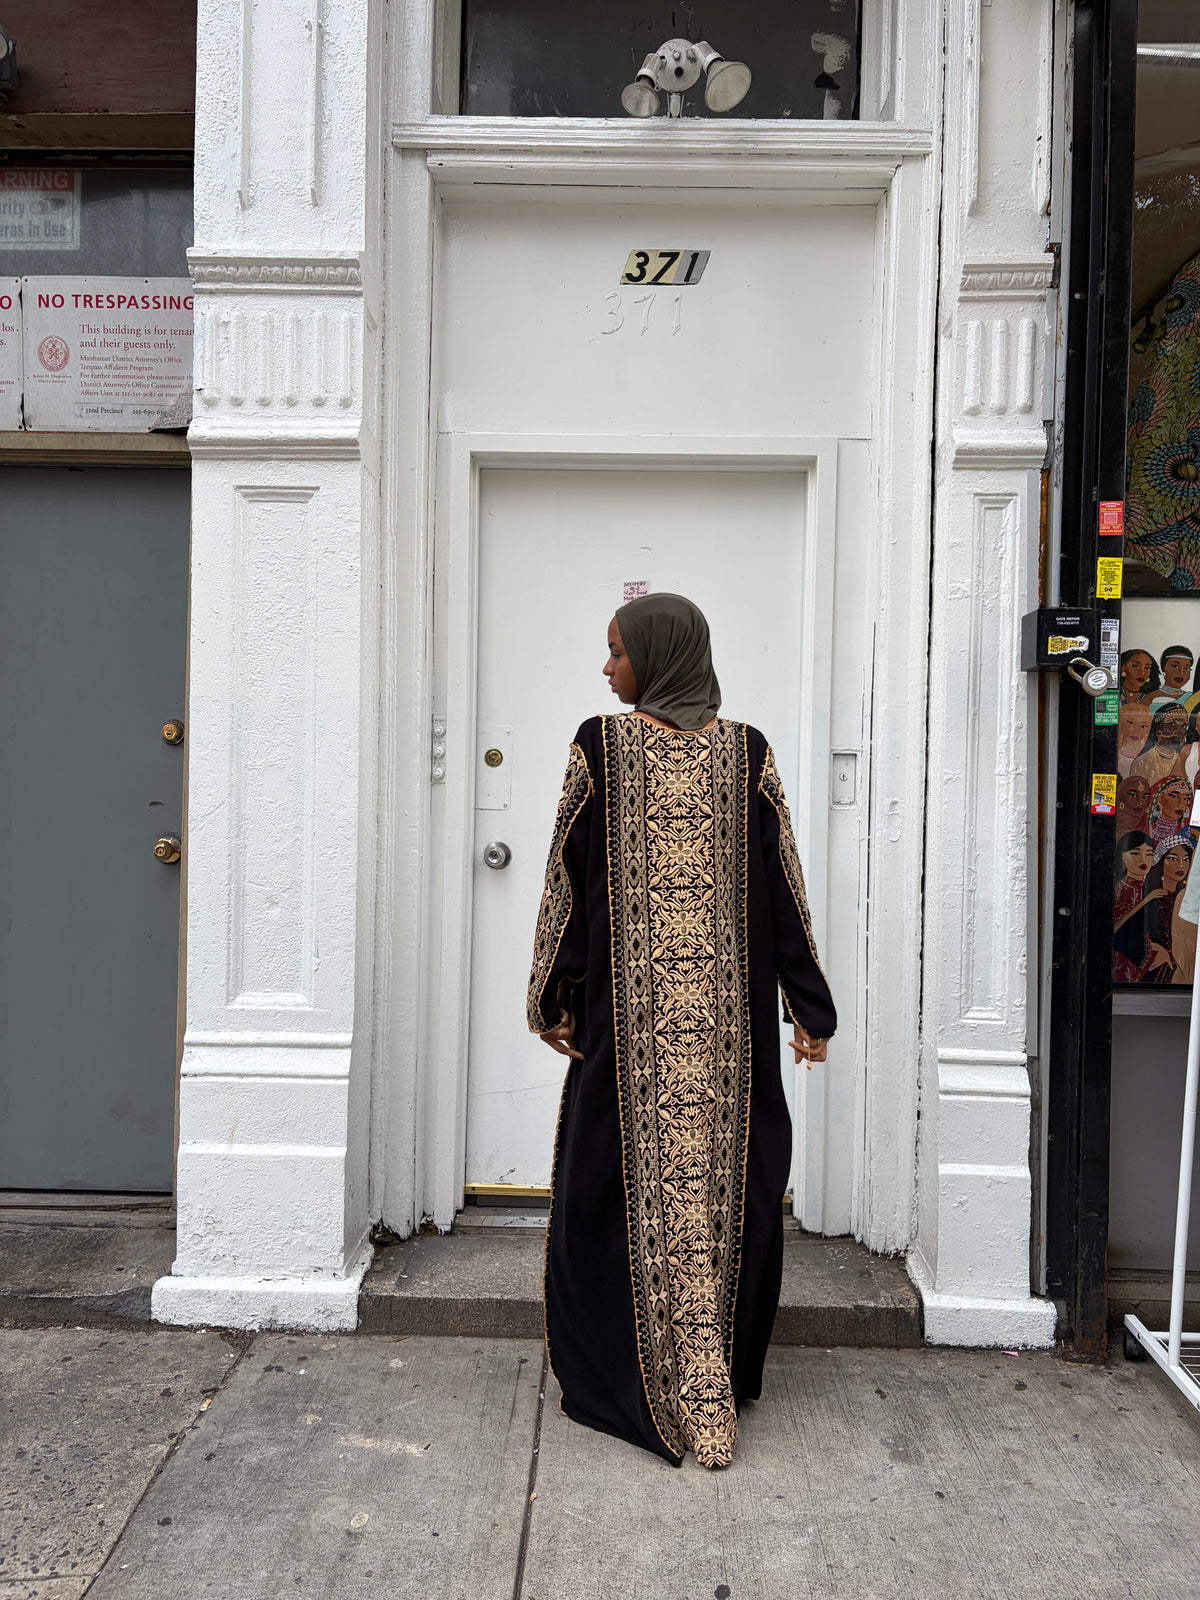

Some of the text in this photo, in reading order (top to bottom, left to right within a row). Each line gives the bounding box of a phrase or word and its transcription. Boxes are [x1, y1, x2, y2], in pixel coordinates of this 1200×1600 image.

[44, 220, 66, 238] Use
[625, 251, 700, 283] 371
[38, 294, 194, 311] NO TRESPASSING
[601, 290, 683, 337] 371
[80, 324, 101, 335] This
[103, 324, 142, 338] building
[144, 325, 152, 335] is
[154, 325, 167, 336] for
[80, 338, 176, 352] and their guests only.
[80, 354, 182, 364] Manhattan District Attorney's Office
[80, 363, 154, 373] Trespass Affidavit Program
[91, 372, 111, 380] further
[112, 372, 145, 380] information
[146, 373, 164, 382] please
[80, 380, 101, 388] District
[103, 381, 131, 390] Attorney's
[132, 381, 150, 389] Office
[80, 389, 99, 397] Affairs
[100, 389, 113, 397] Unit
[100, 406, 124, 415] Precinct
